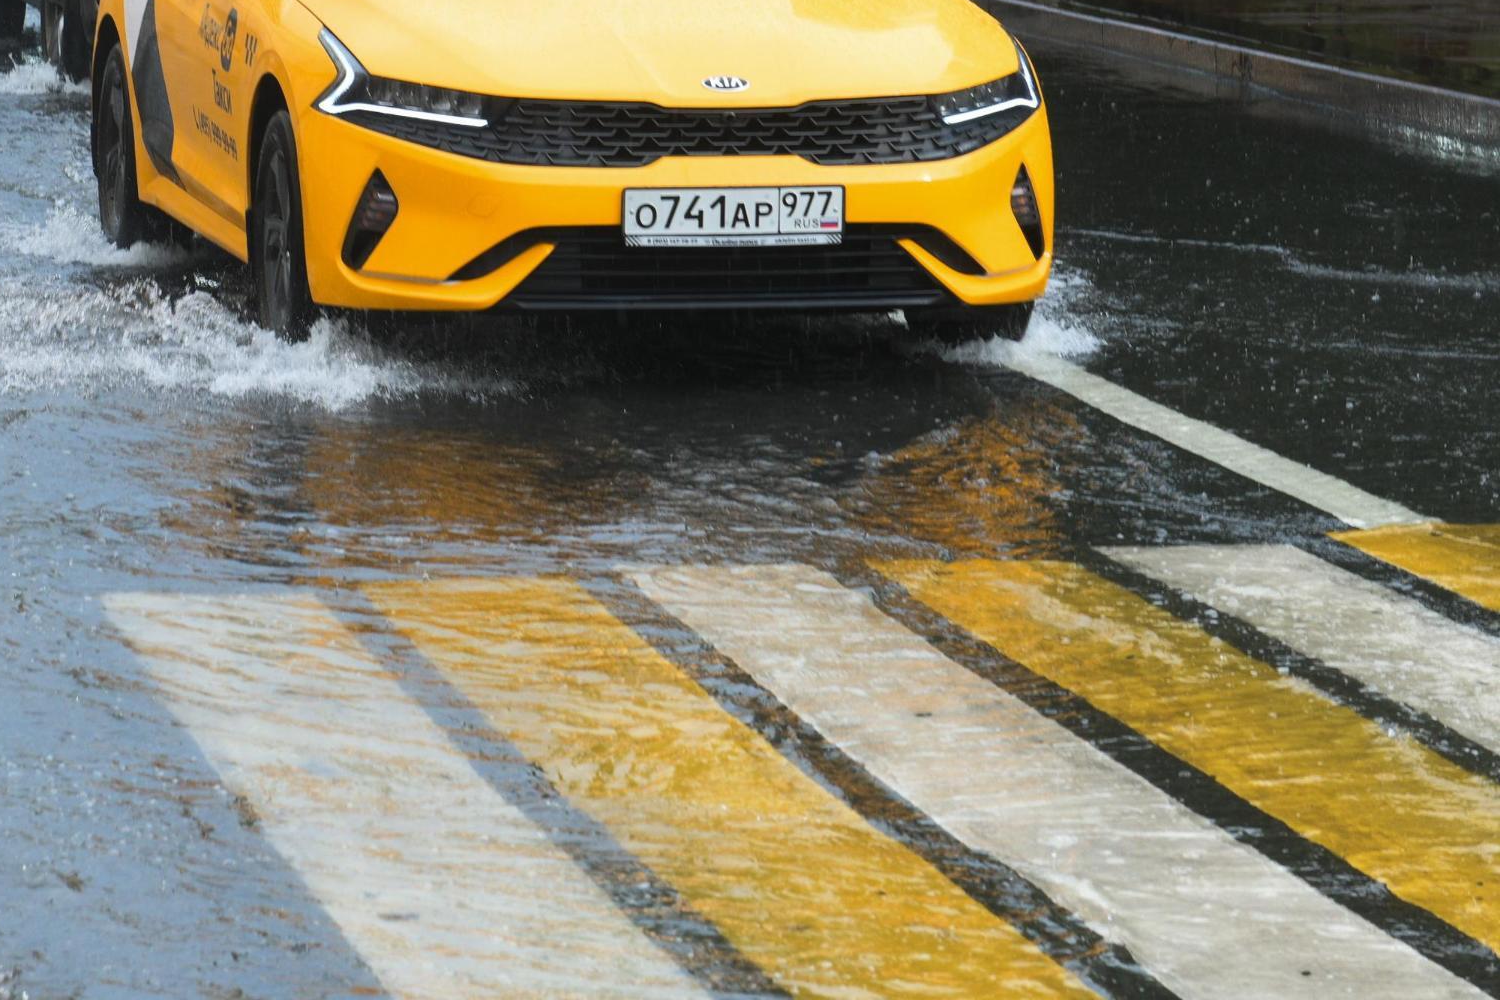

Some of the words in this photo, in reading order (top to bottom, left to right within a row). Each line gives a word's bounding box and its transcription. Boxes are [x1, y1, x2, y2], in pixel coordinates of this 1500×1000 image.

[708, 76, 745, 88] KIA
[635, 195, 773, 229] О741АР
[782, 191, 833, 217] 977
[794, 219, 819, 228] RUS
